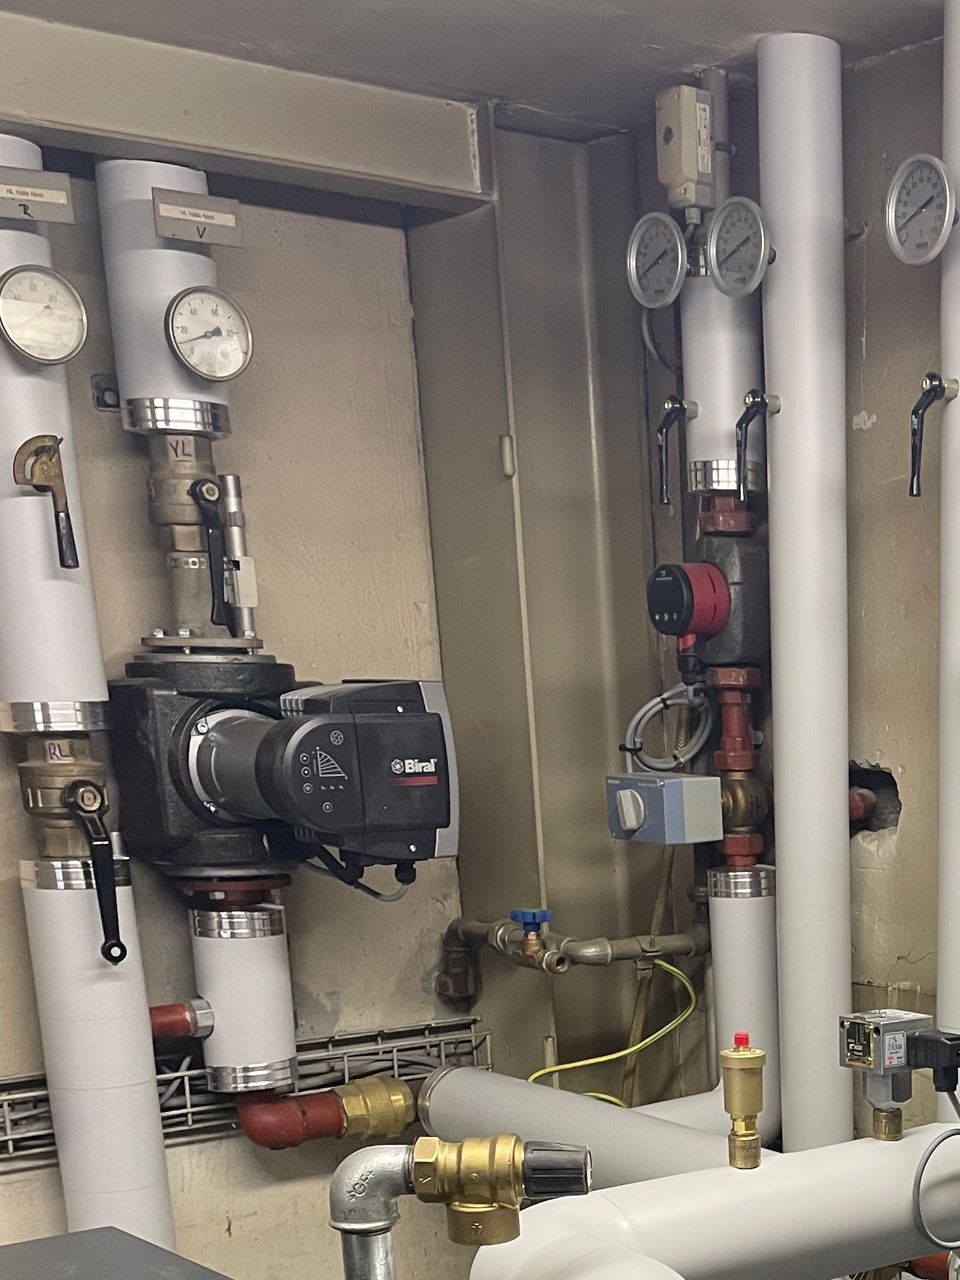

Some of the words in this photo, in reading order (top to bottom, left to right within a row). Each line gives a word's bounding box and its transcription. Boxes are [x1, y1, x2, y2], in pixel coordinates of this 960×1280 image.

[18, 203, 34, 219] R
[196, 225, 207, 239] V
[48, 743, 71, 760] RL
[404, 758, 437, 773] Biral
